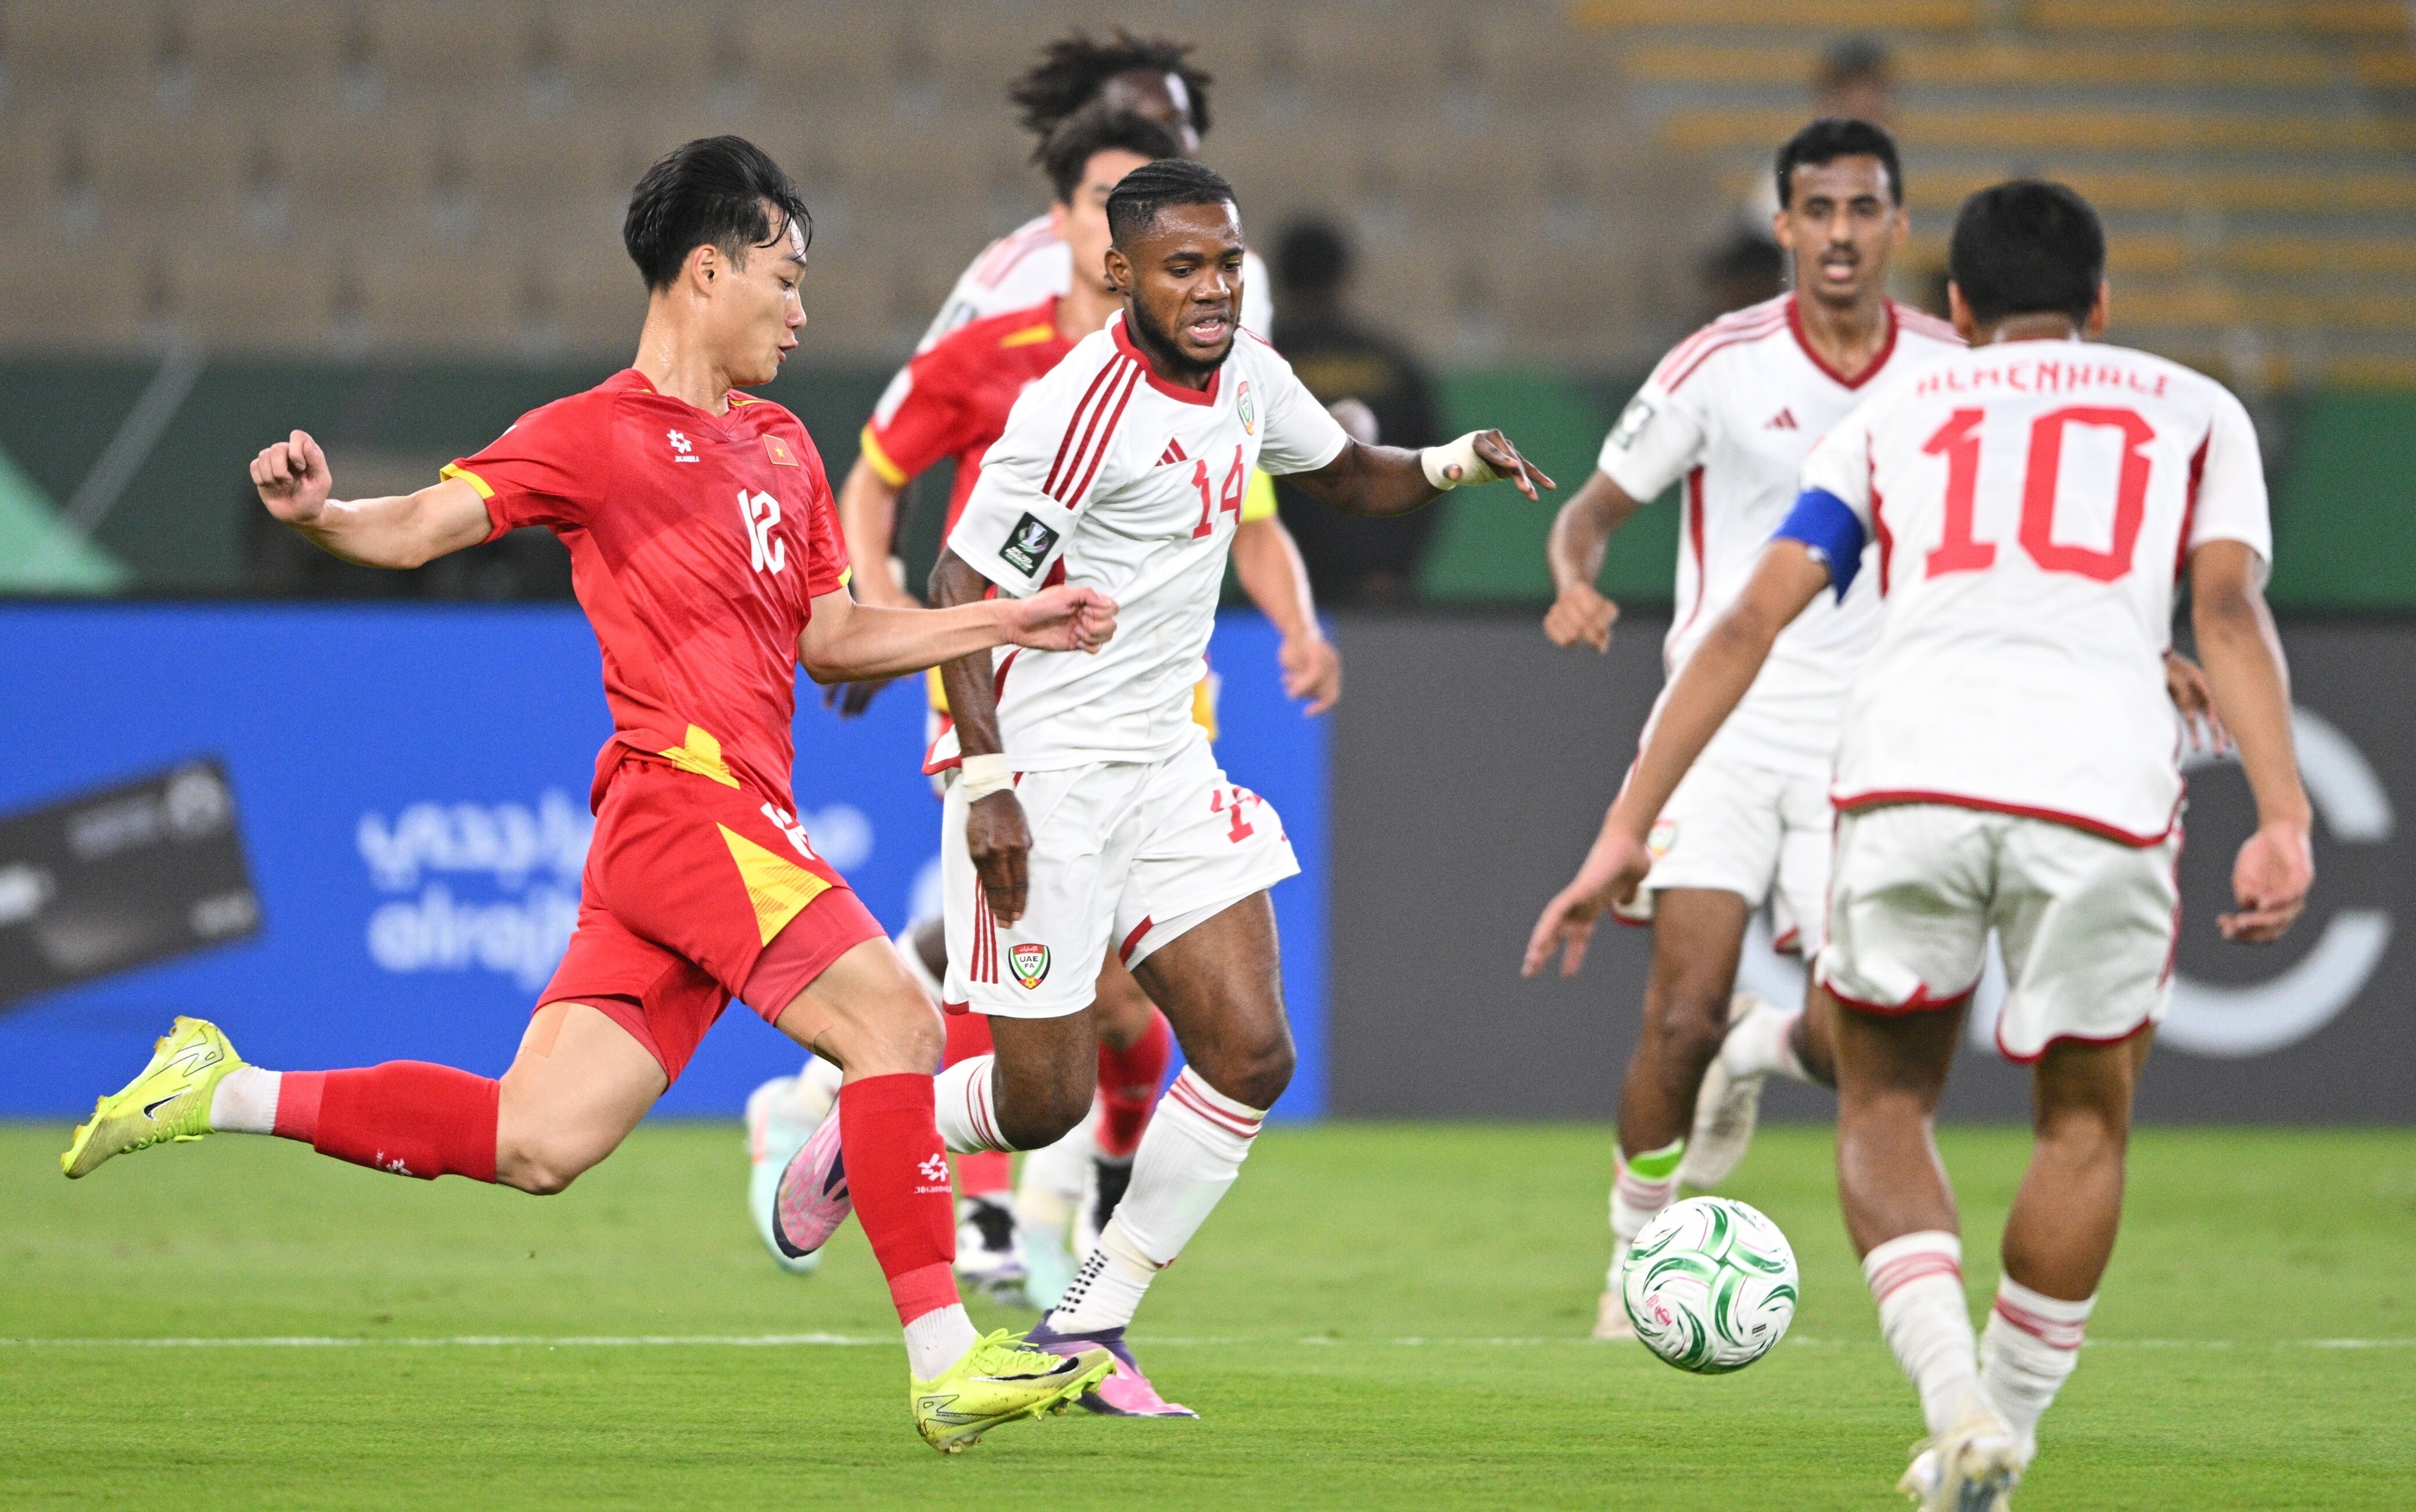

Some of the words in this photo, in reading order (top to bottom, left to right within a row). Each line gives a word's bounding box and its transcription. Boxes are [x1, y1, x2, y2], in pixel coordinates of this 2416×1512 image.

[737, 489, 785, 574] 12
[1191, 444, 1243, 540] 14
[1921, 405, 2157, 583] 10
